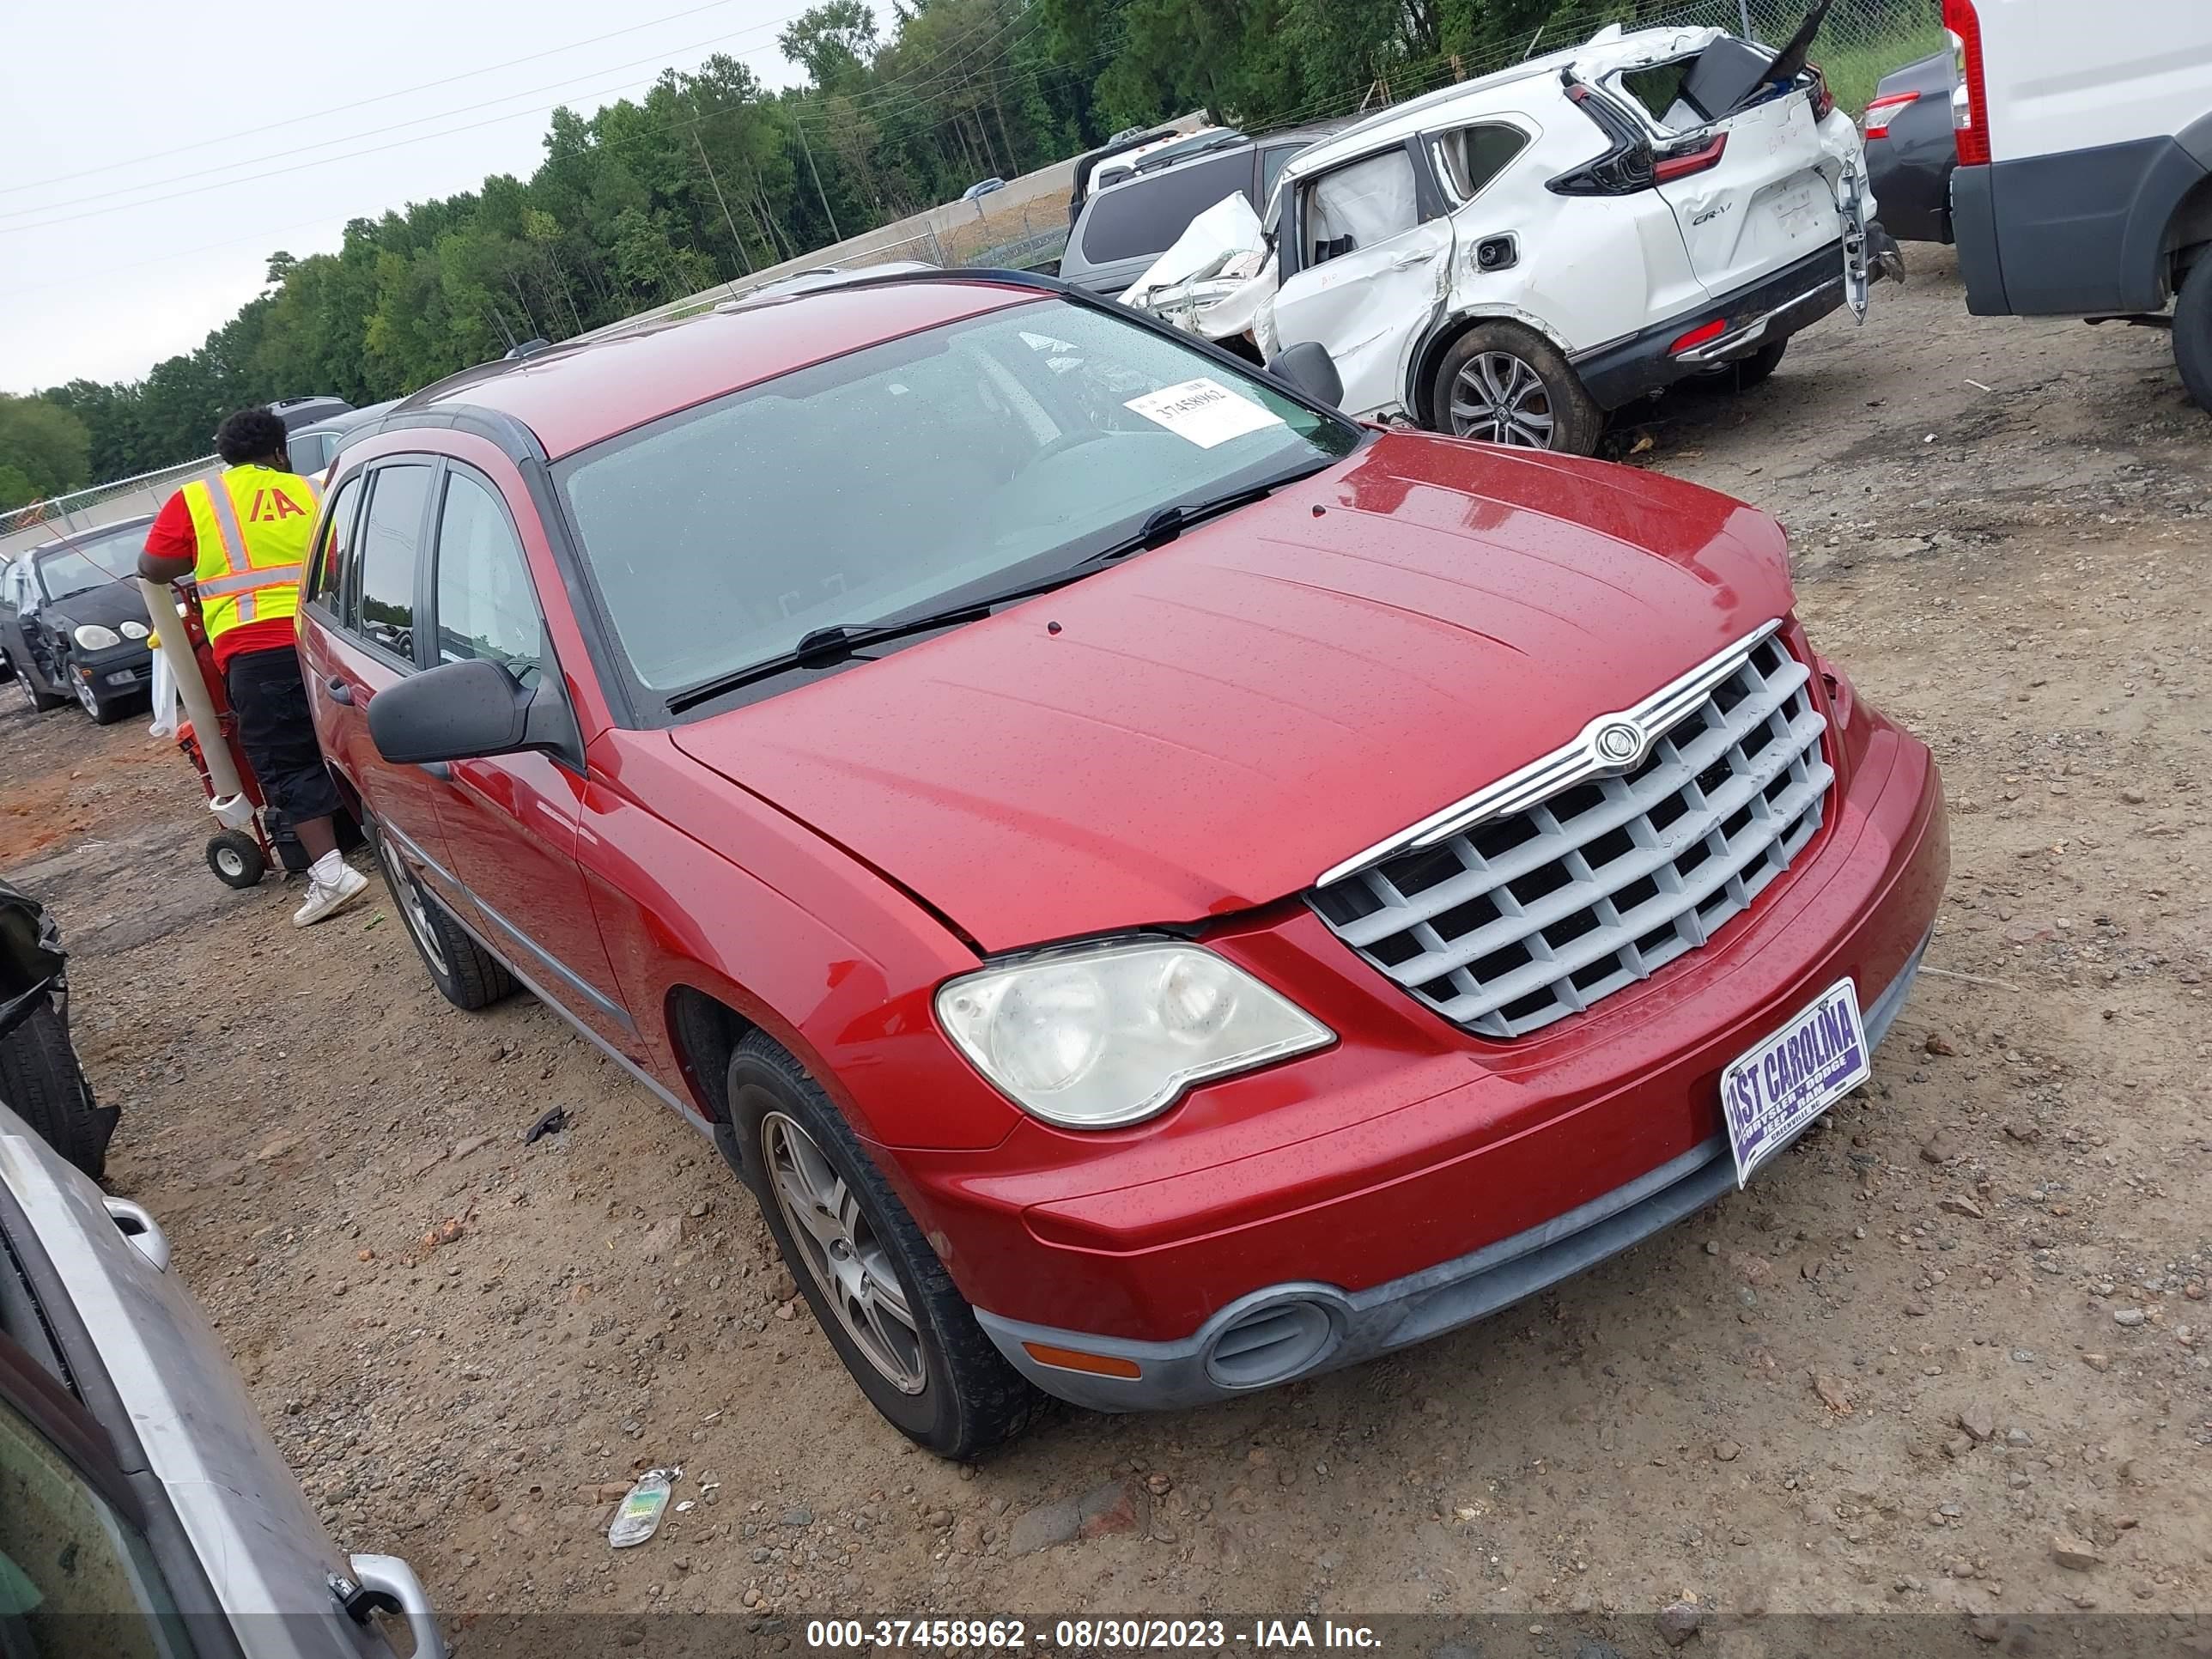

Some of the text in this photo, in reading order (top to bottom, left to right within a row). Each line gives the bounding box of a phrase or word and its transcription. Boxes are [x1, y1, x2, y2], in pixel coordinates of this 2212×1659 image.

[1692, 202, 1732, 226] CR-V
[1156, 390, 1227, 419] 37458962
[1764, 998, 1856, 1103] CAROLINA
[1741, 1057, 1847, 1146] CHRYSLER DODGE
[1762, 1082, 1826, 1138] JEEP RAM
